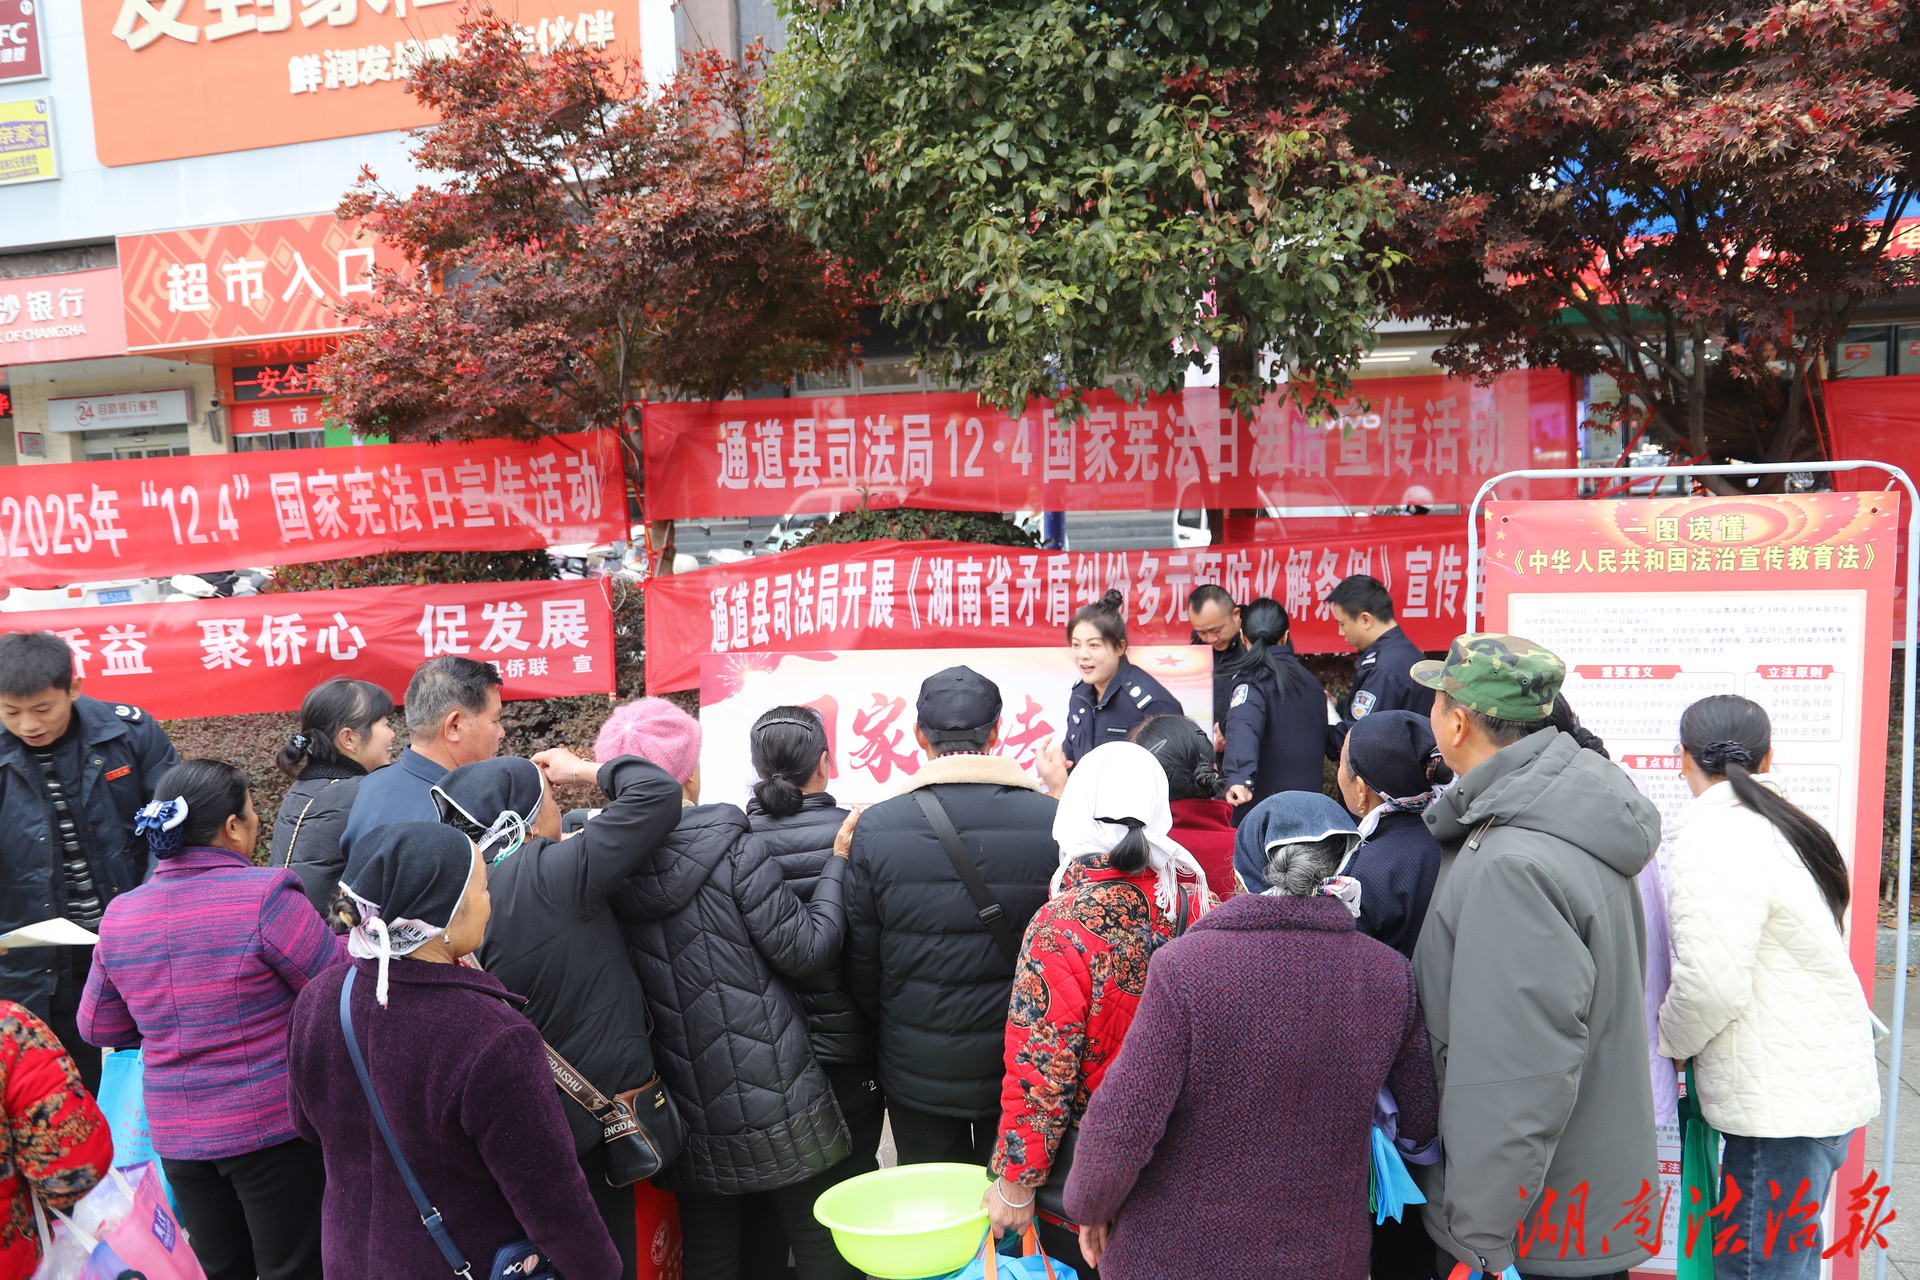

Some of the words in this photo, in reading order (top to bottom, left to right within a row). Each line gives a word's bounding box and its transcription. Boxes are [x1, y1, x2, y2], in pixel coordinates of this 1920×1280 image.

[167, 247, 376, 313] 超市入口
[23, 323, 87, 342] CHANGSHA
[76, 405, 95, 421] 24
[98, 399, 159, 416] 自助银行服务
[252, 405, 309, 428] 超市
[1624, 514, 1745, 543] 一图读懂
[1514, 543, 1878, 577] 《中华人民共和国法治宣传教育法》
[197, 611, 366, 670] 聚侨心
[417, 599, 590, 656] 促发展
[572, 654, 593, 673] 宣
[1601, 666, 1654, 679] 重要意义
[1767, 666, 1823, 679] 立法原则
[1770, 713, 1832, 722] 坚持人民立场
